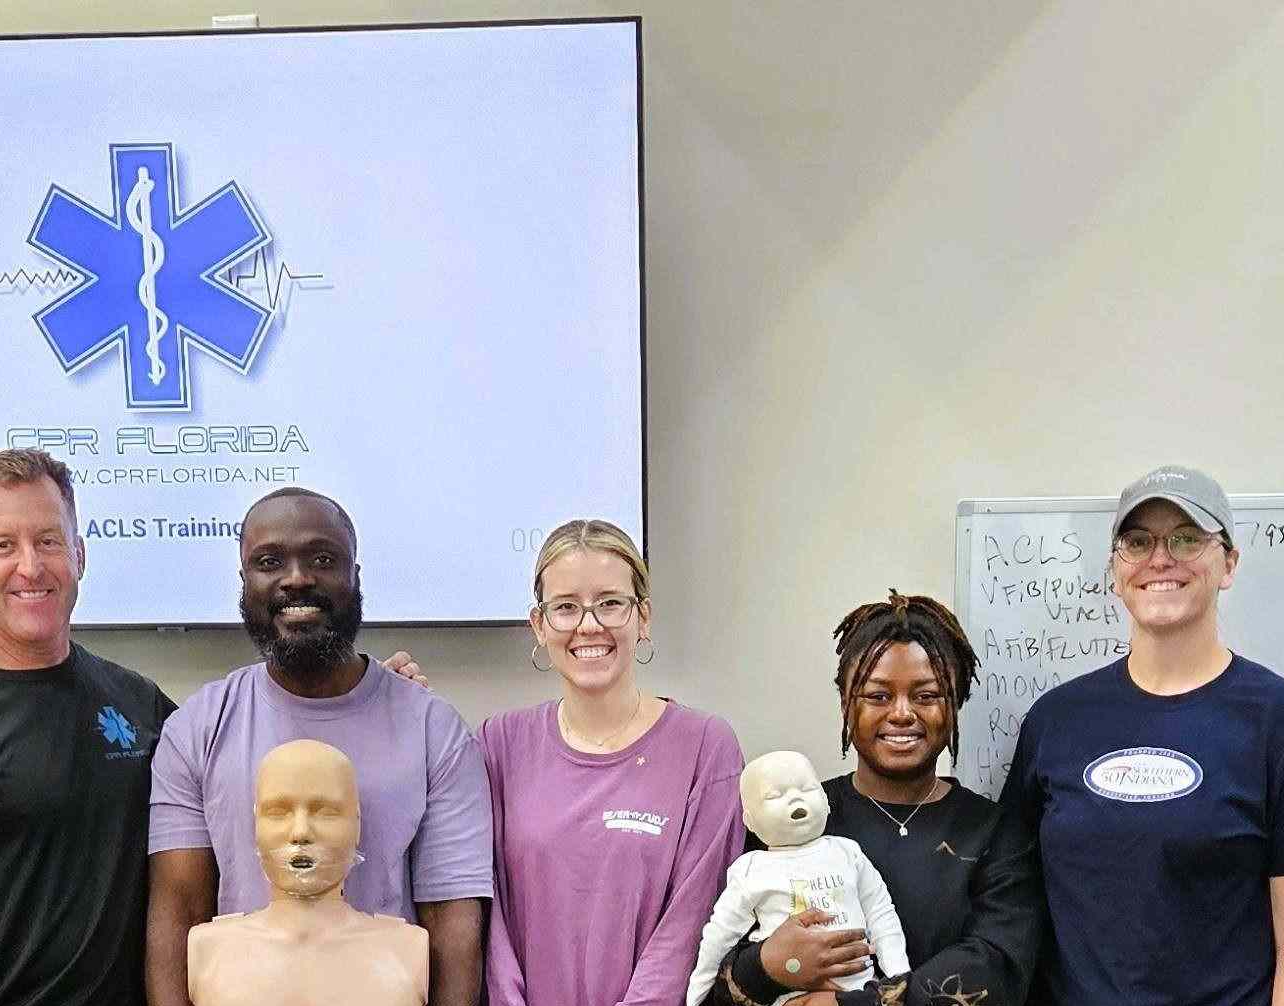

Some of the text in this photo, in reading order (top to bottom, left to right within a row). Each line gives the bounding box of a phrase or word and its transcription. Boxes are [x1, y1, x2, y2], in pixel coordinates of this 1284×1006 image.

[7, 424, 310, 455] CPR FLORIDA
[70, 466, 300, 484] W.CPRFLORIDA.NET
[86, 518, 244, 542] ACLS Training
[984, 532, 1083, 572] ACLS
